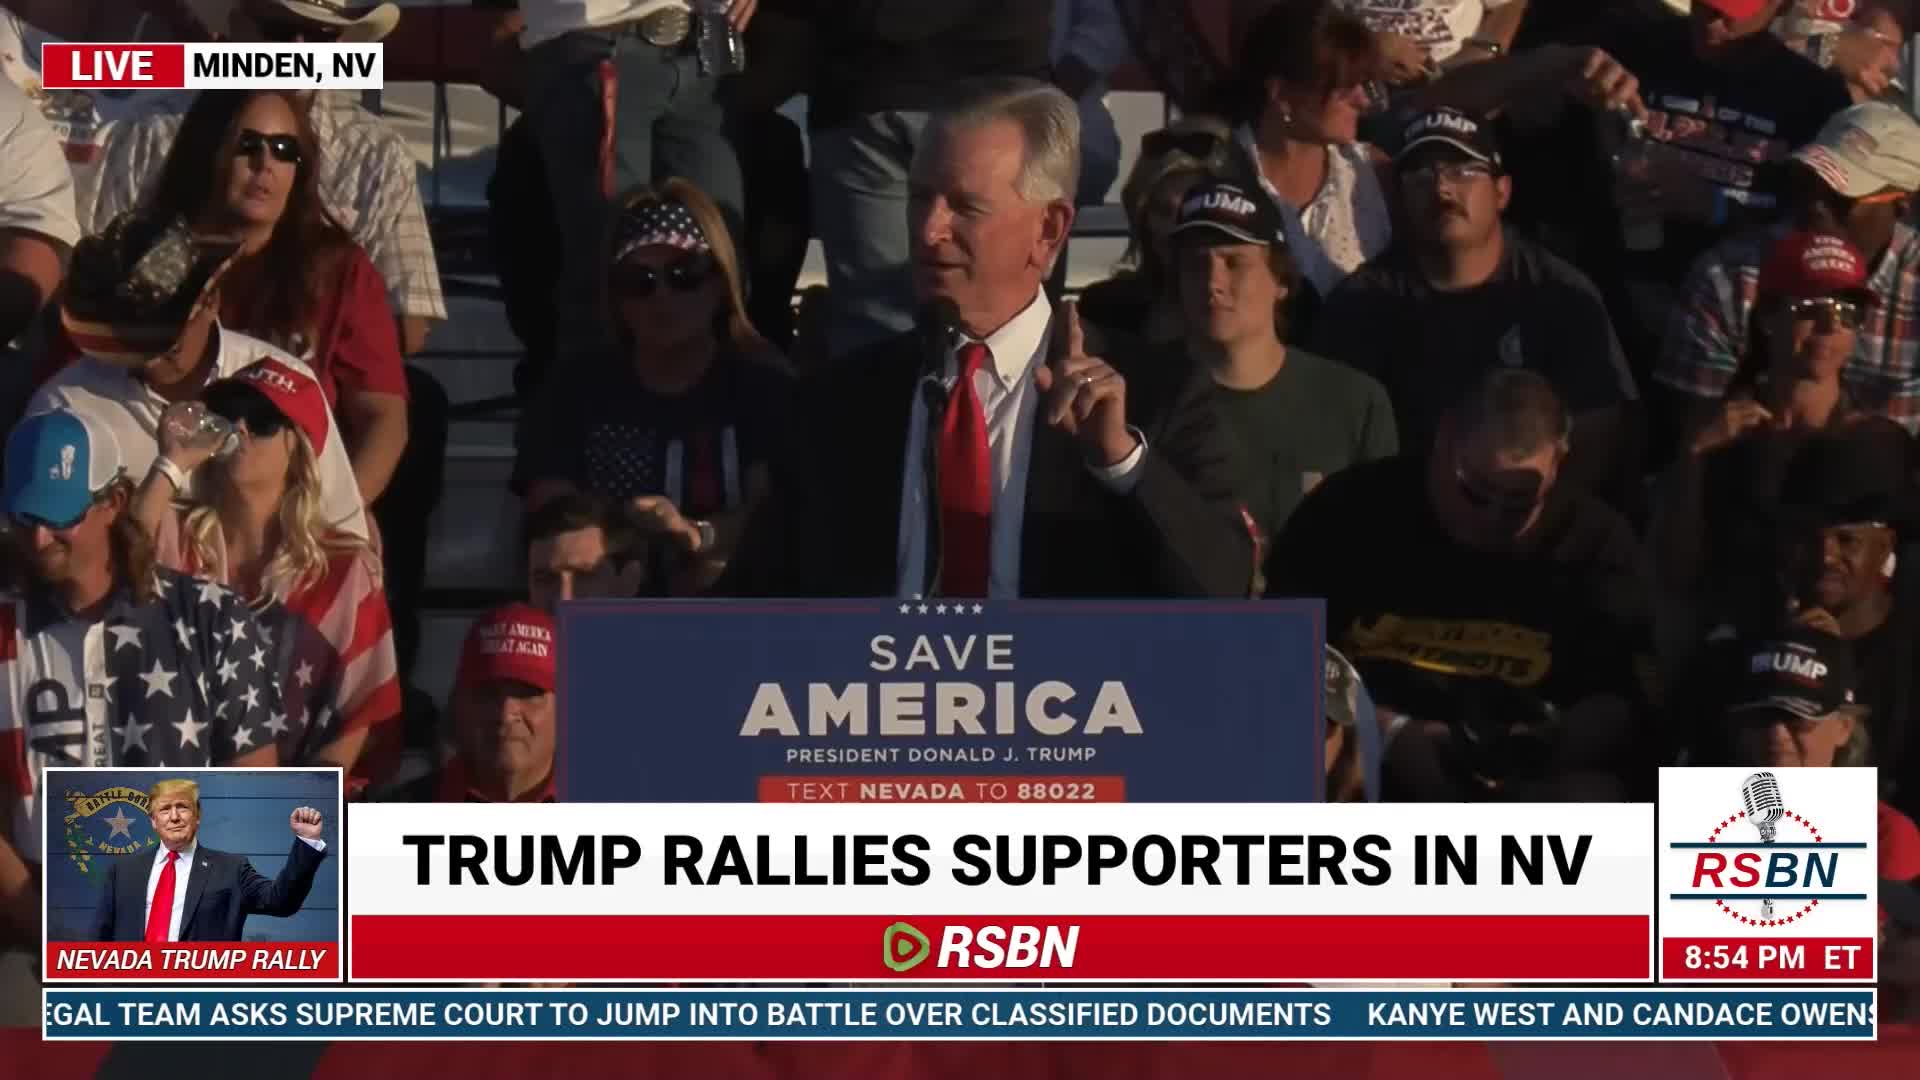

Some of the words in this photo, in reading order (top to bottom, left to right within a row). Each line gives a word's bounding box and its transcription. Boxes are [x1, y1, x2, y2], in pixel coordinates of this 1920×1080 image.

[509, 622, 552, 641] AMERICA
[516, 640, 548, 657] AGAIN
[869, 633, 1014, 671] SAVE
[1752, 652, 1828, 679] UMP
[739, 682, 1143, 736] AMERICA
[786, 748, 901, 764] PRESIDENT
[908, 747, 996, 763] DONALD
[1003, 747, 1019, 762] J.
[1027, 746, 1097, 763] TRUMP
[788, 783, 849, 800] TEXT
[860, 783, 965, 800] NEVADA
[976, 783, 1008, 800] TO
[1017, 783, 1095, 801] 88022
